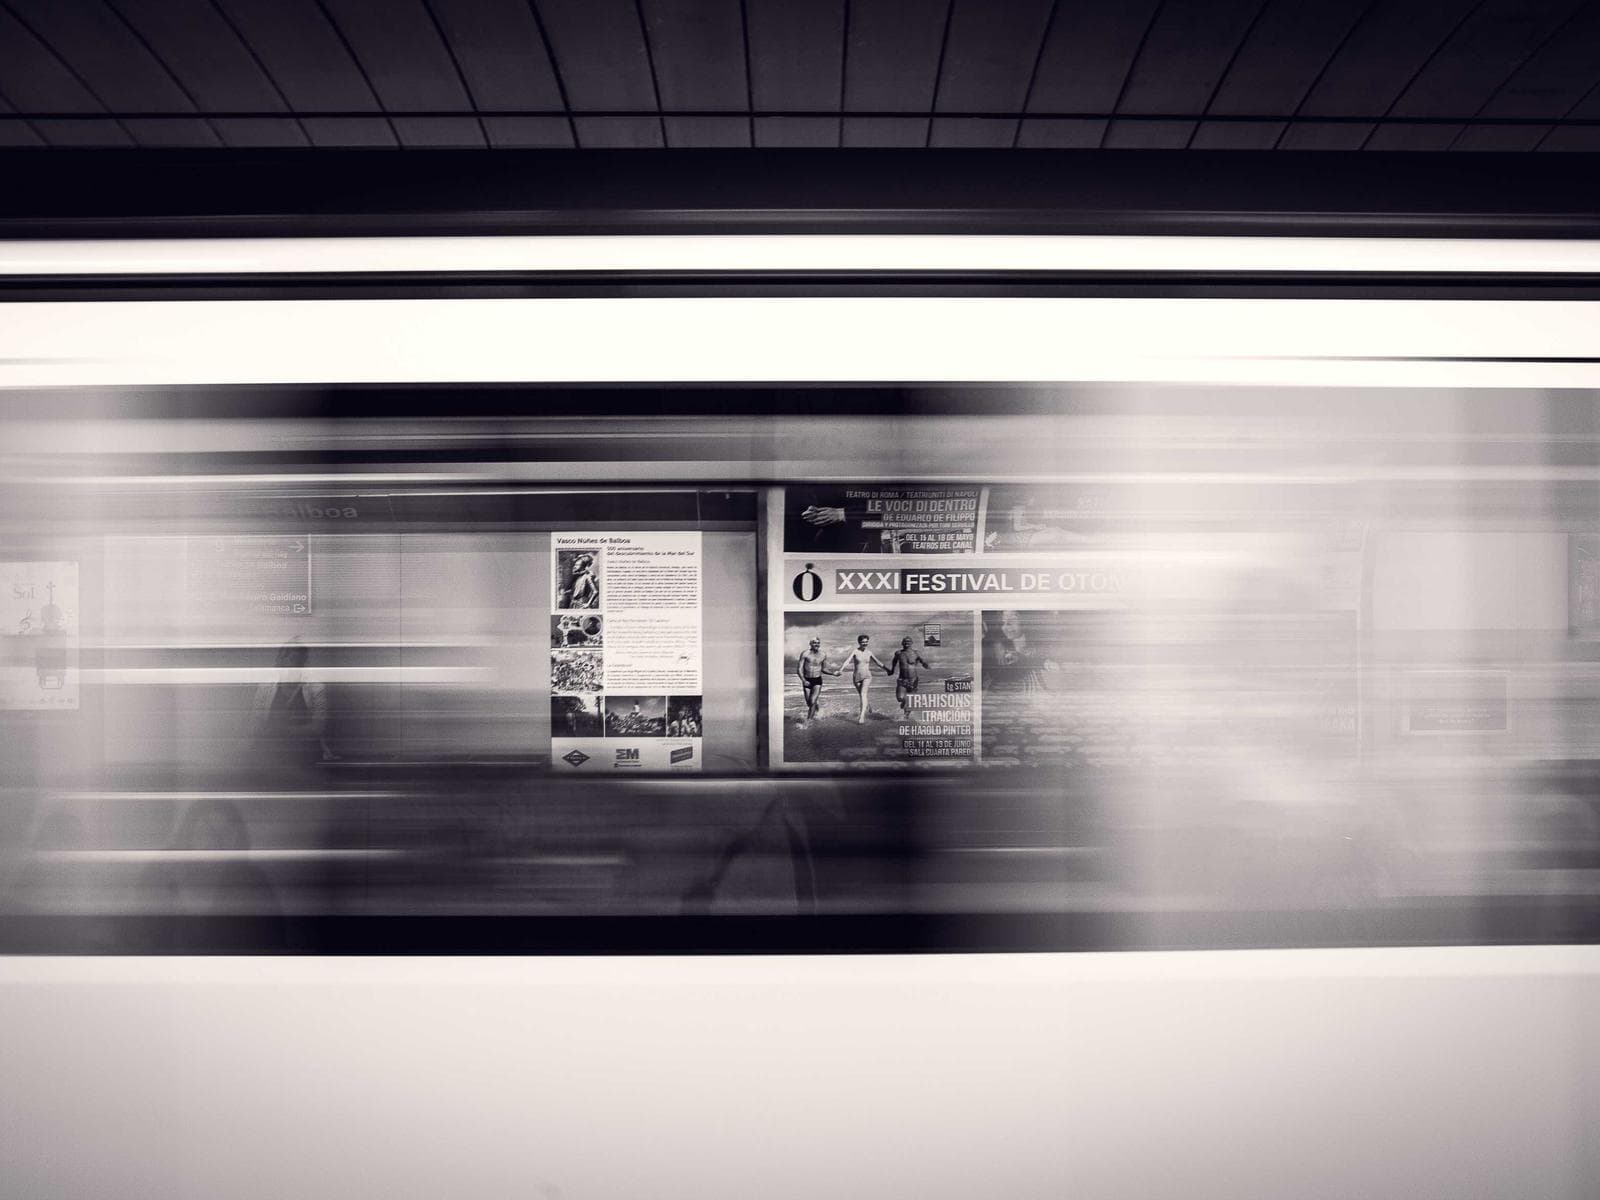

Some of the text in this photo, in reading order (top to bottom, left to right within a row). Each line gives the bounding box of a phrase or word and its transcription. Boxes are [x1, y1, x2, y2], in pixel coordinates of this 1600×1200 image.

[846, 490, 870, 499] TEATRO
[867, 499, 977, 512] LE VOCI DI DENTRO
[883, 513, 894, 522] DE
[933, 513, 944, 522] DE
[945, 512, 975, 522] FILIPPO
[905, 533, 917, 541] DEL
[927, 533, 936, 541] AL
[946, 533, 955, 541] DE
[956, 533, 974, 541] MAYO
[911, 541, 974, 550] TEATROS DEL CANAL
[838, 572, 899, 590] XXXI
[906, 573, 1013, 592] FESTIVAL
[1020, 573, 1051, 591] DE
[955, 682, 971, 690] STAN
[906, 694, 971, 708] TRAHISONS
[899, 725, 971, 736] DE HAROLD PINTER
[904, 740, 916, 748] DEL
[925, 740, 934, 748] AL
[944, 740, 952, 748] DE
[954, 740, 971, 748] JUNIO
